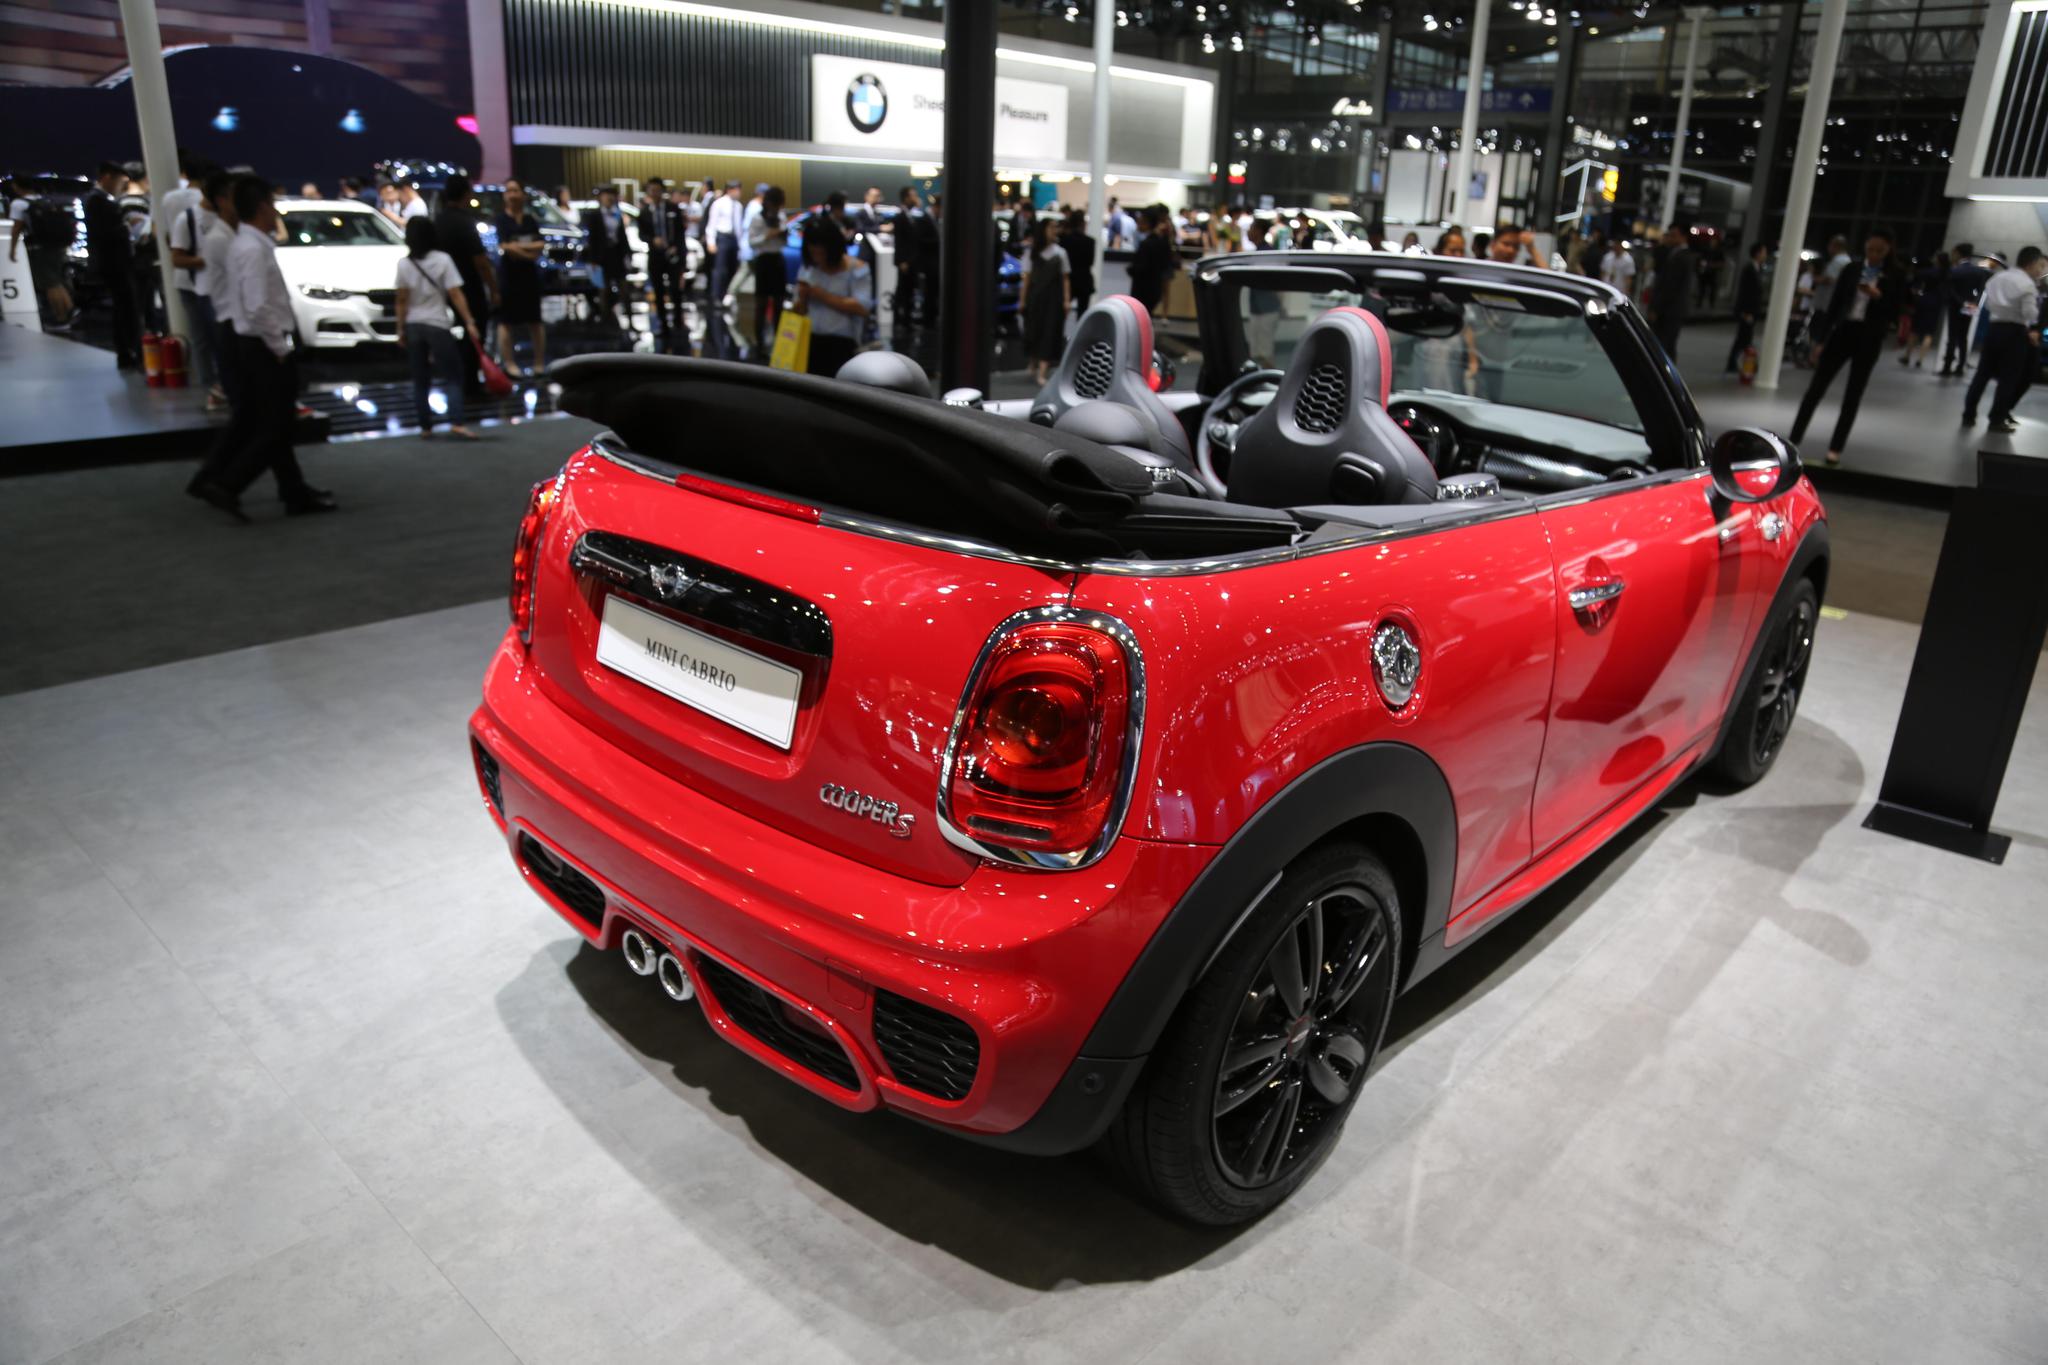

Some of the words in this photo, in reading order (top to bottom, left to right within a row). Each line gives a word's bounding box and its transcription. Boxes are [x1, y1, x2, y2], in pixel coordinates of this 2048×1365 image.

[912, 94, 945, 112] Shee
[1000, 103, 1049, 122] Pleasure
[2, 279, 19, 300] 5
[645, 637, 679, 668] MINI
[679, 653, 737, 692] CABRIO
[819, 782, 899, 827] COOPER
[889, 813, 916, 838] S
